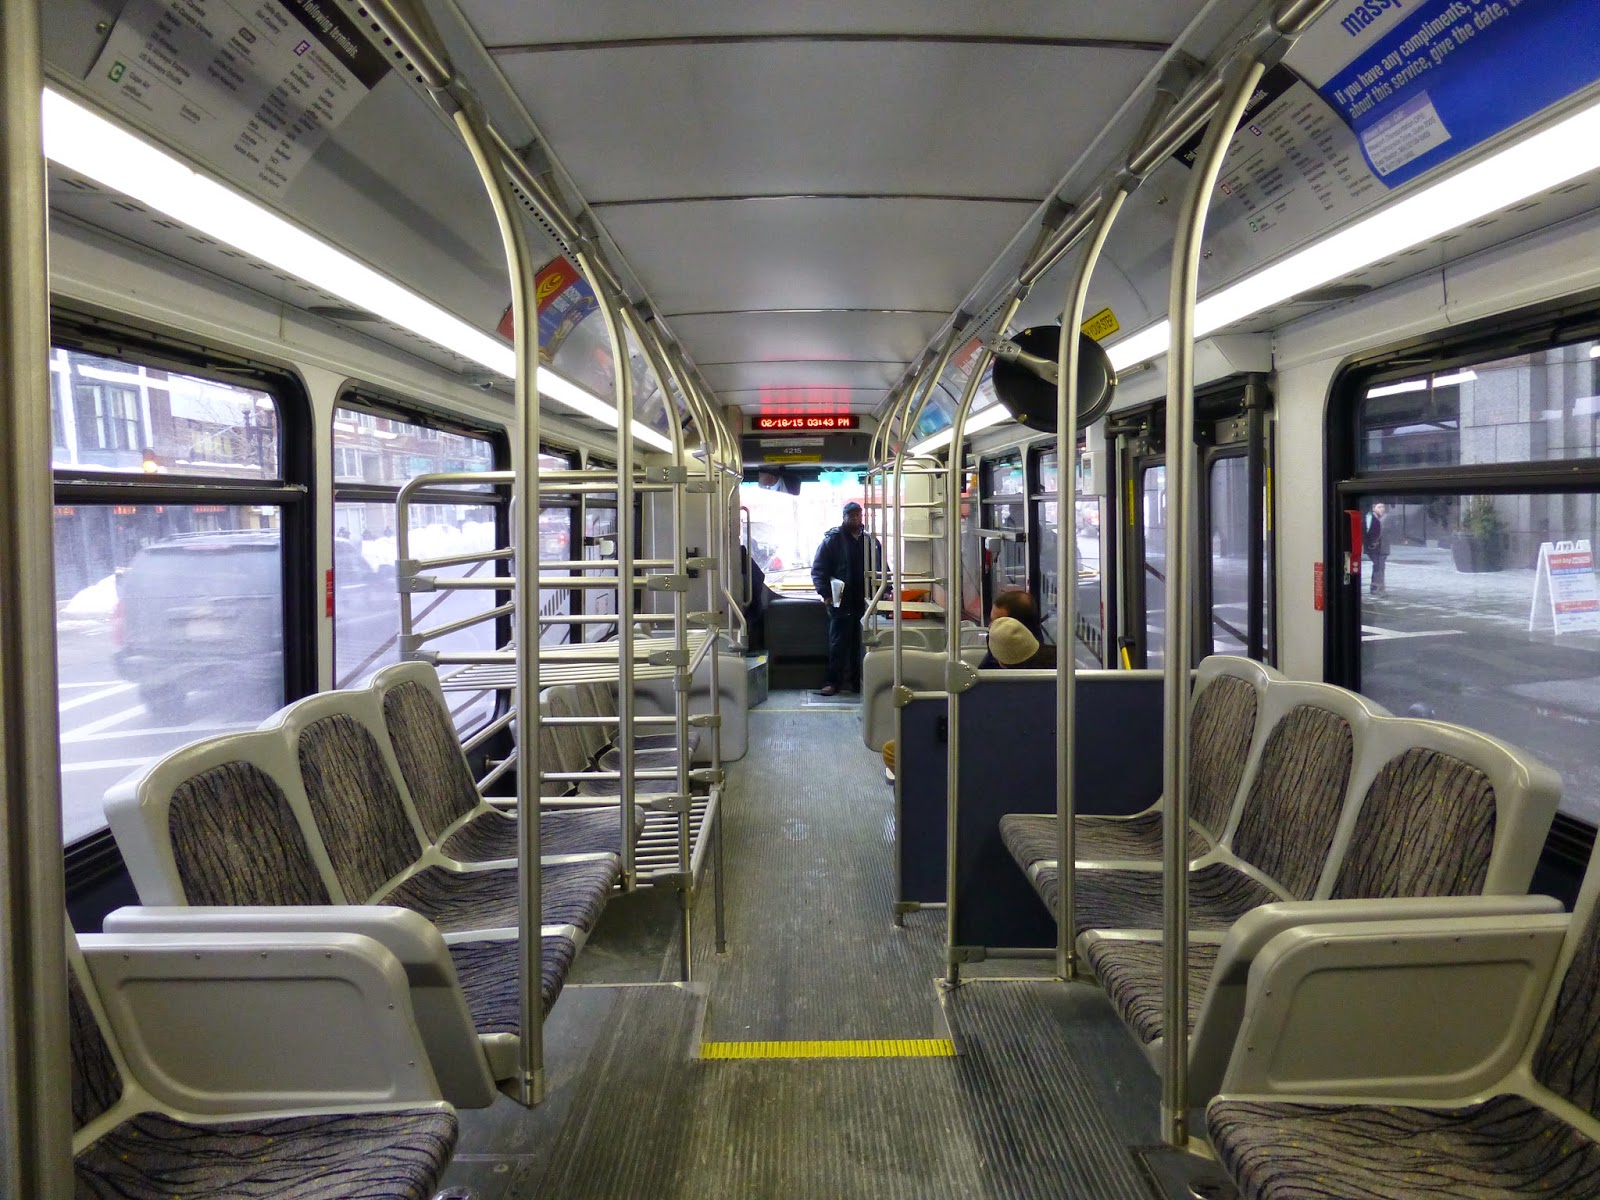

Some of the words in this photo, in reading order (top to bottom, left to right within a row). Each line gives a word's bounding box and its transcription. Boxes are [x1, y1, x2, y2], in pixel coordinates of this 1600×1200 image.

[302, 0, 334, 33] following
[329, 26, 359, 59] terminals.
[1335, 89, 1347, 105] If
[1343, 81, 1362, 101] you
[1357, 65, 1385, 87] have
[1381, 50, 1404, 71] any
[1399, 0, 1473, 57] compliments,
[1349, 92, 1376, 119] about
[1371, 79, 1393, 102] this
[1390, 55, 1433, 89] service,
[1429, 38, 1456, 65] give
[1451, 22, 1475, 44] the
[1473, 1, 1510, 30] date,
[807, 418, 834, 427] 03:43
[837, 418, 850, 427] PM
